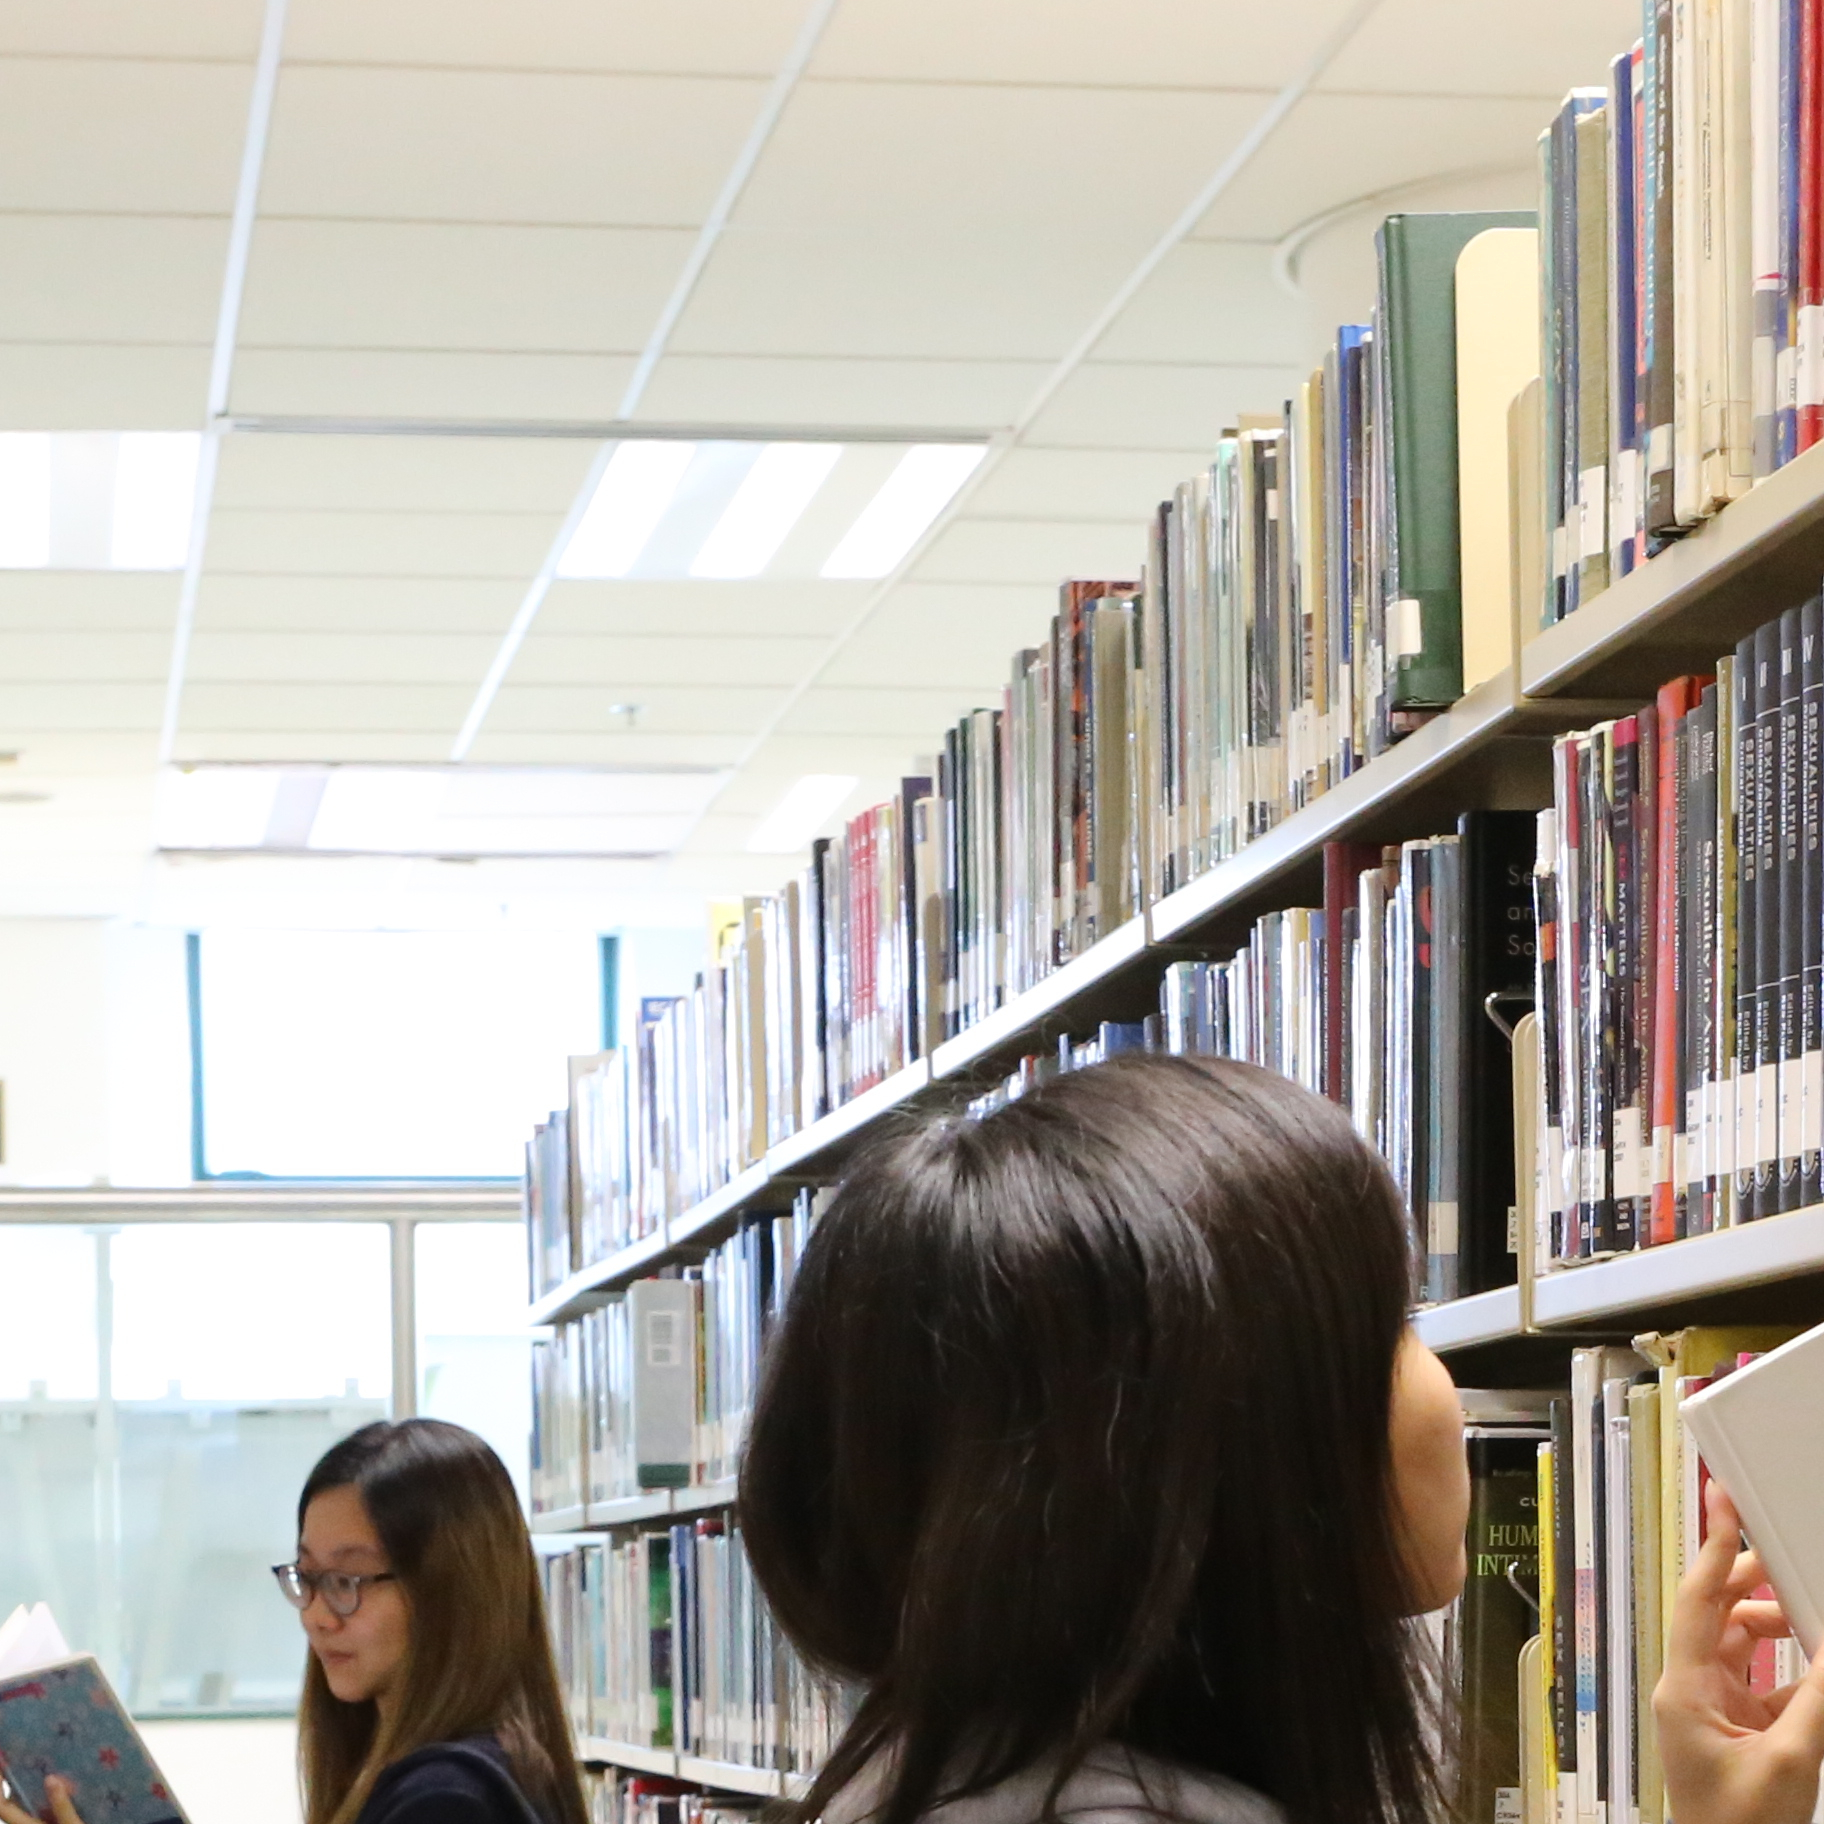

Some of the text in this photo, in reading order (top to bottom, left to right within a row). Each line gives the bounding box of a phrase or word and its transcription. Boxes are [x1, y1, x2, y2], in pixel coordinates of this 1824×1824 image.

[1745, 738, 1755, 882] SEXUALITIES
[1763, 725, 1773, 870] SEXUALITIES
[1786, 714, 1796, 860] SEXUALITIES
[1807, 701, 1818, 850] SEXUALITIES
[1618, 882, 1627, 976] MATTERS
[1702, 839, 1713, 968] Sexuality
[1488, 1523, 1539, 1547] HUM
